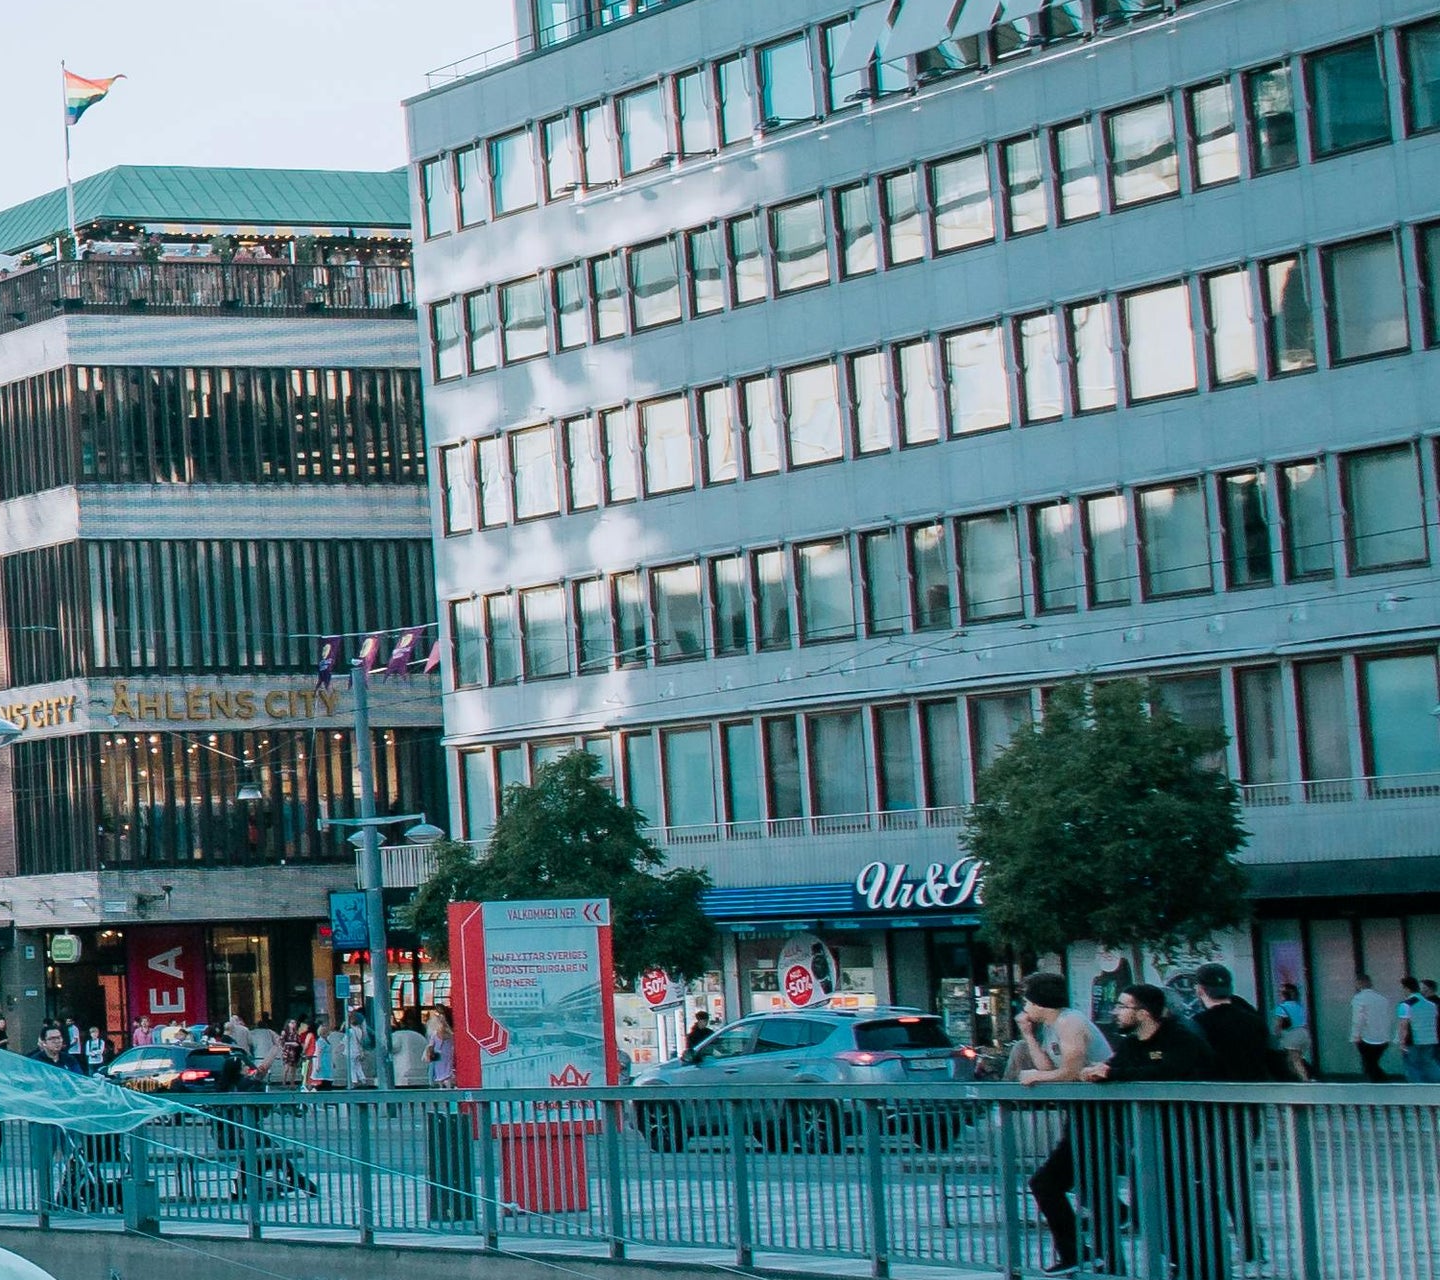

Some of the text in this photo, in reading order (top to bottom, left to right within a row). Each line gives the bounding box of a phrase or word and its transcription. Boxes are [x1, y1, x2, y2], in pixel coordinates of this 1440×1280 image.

[29, 695, 77, 730] CITY
[263, 688, 342, 719] CITY
[786, 978, 814, 998] -50%
